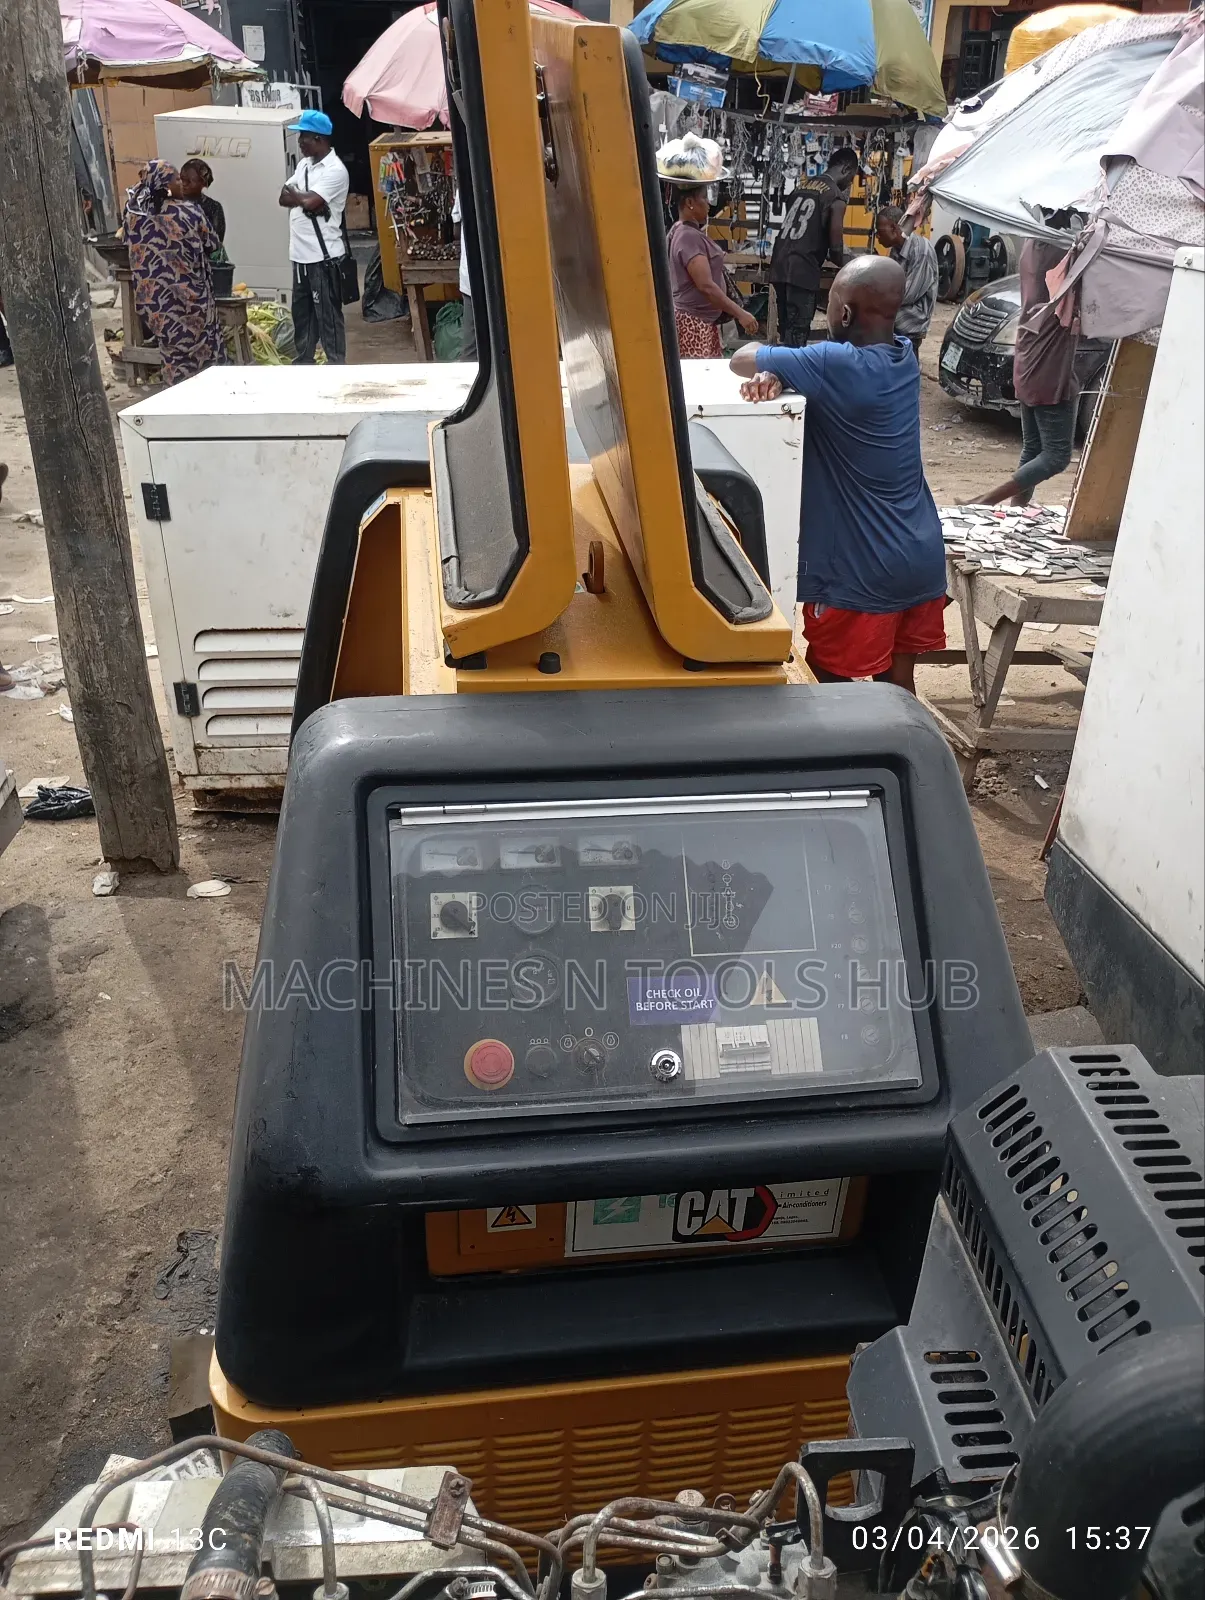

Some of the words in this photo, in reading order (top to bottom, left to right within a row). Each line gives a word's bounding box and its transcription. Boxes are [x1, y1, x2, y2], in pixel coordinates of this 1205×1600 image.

[186, 136, 251, 158] JMG
[780, 196, 816, 240] 43
[645, 988, 682, 999] CHECK
[684, 987, 703, 997] OIL
[636, 1001, 679, 1012] BEFORE
[681, 999, 714, 1011] START
[780, 1188, 830, 1198] imited
[677, 1188, 755, 1236] CAT
